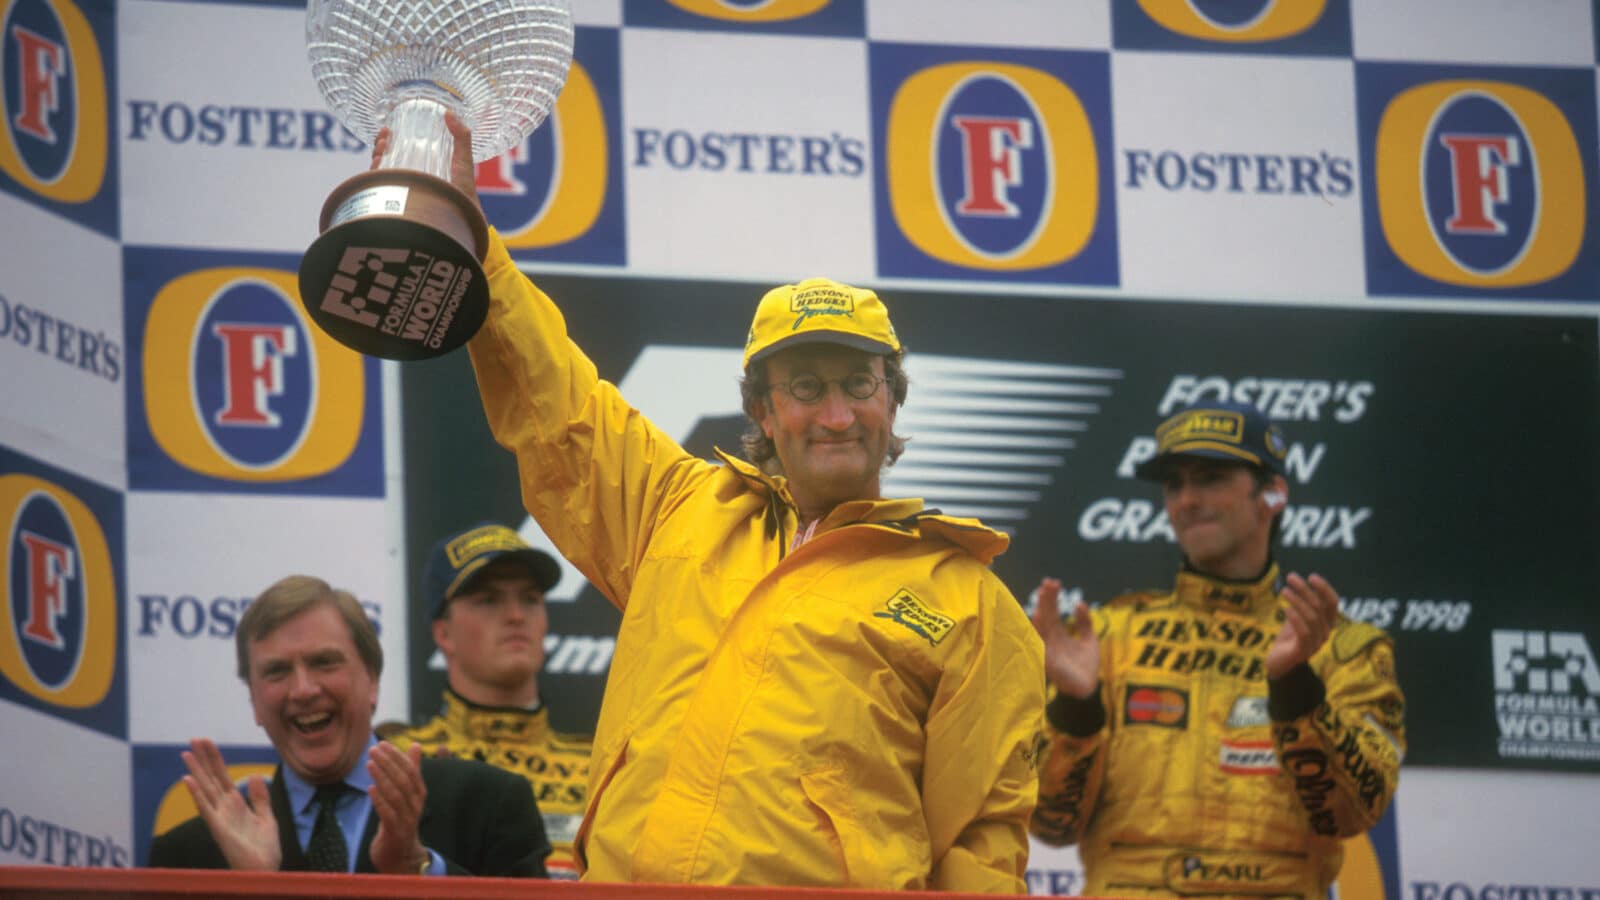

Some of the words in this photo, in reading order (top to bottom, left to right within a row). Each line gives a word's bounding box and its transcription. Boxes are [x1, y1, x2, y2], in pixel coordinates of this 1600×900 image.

[127, 100, 367, 153] FOSTERS
[633, 128, 865, 177] FOSTER'S
[1124, 148, 1354, 196] FOSTER'S
[381, 264, 426, 335] FORMULA
[401, 260, 455, 340] WORLD
[795, 288, 844, 300] BENSON
[796, 297, 847, 307] HEDGES
[1157, 374, 1375, 423] FOSTER'S
[1077, 498, 1176, 542] GRA
[1137, 619, 1276, 648] BENSO
[1401, 599, 1471, 632] 1998
[1136, 643, 1264, 681] HEDGE
[1495, 693, 1599, 714] FORMULA
